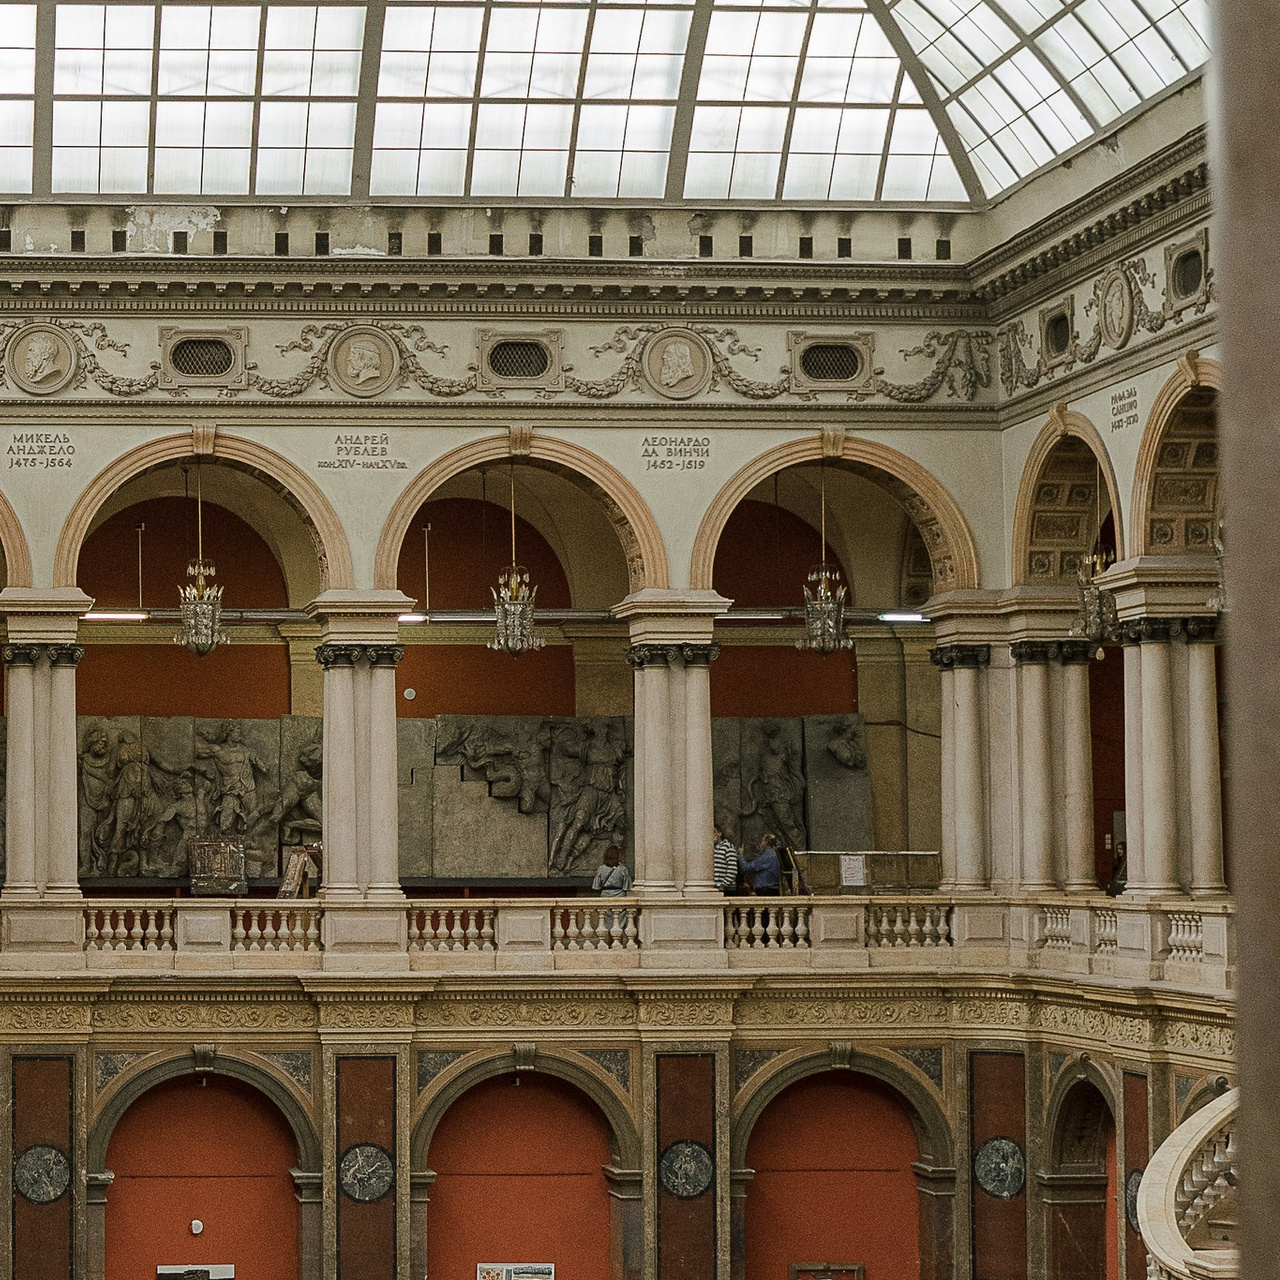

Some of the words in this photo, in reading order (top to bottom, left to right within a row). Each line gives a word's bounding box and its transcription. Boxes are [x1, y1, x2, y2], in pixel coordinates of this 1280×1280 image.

[13, 433, 70, 443] МИКЕЛЬ
[334, 433, 389, 445] АНДРЕЙ
[641, 436, 711, 447] ЛЕОНАРДО
[6, 445, 76, 455] АНДЖЕЛО
[336, 446, 388, 456] РУБЛЕВ
[641, 448, 658, 457] ДА
[666, 448, 710, 457] ВИНЧИ
[8, 458, 73, 469] 1475-1564
[646, 460, 706, 471] 1452-1519
